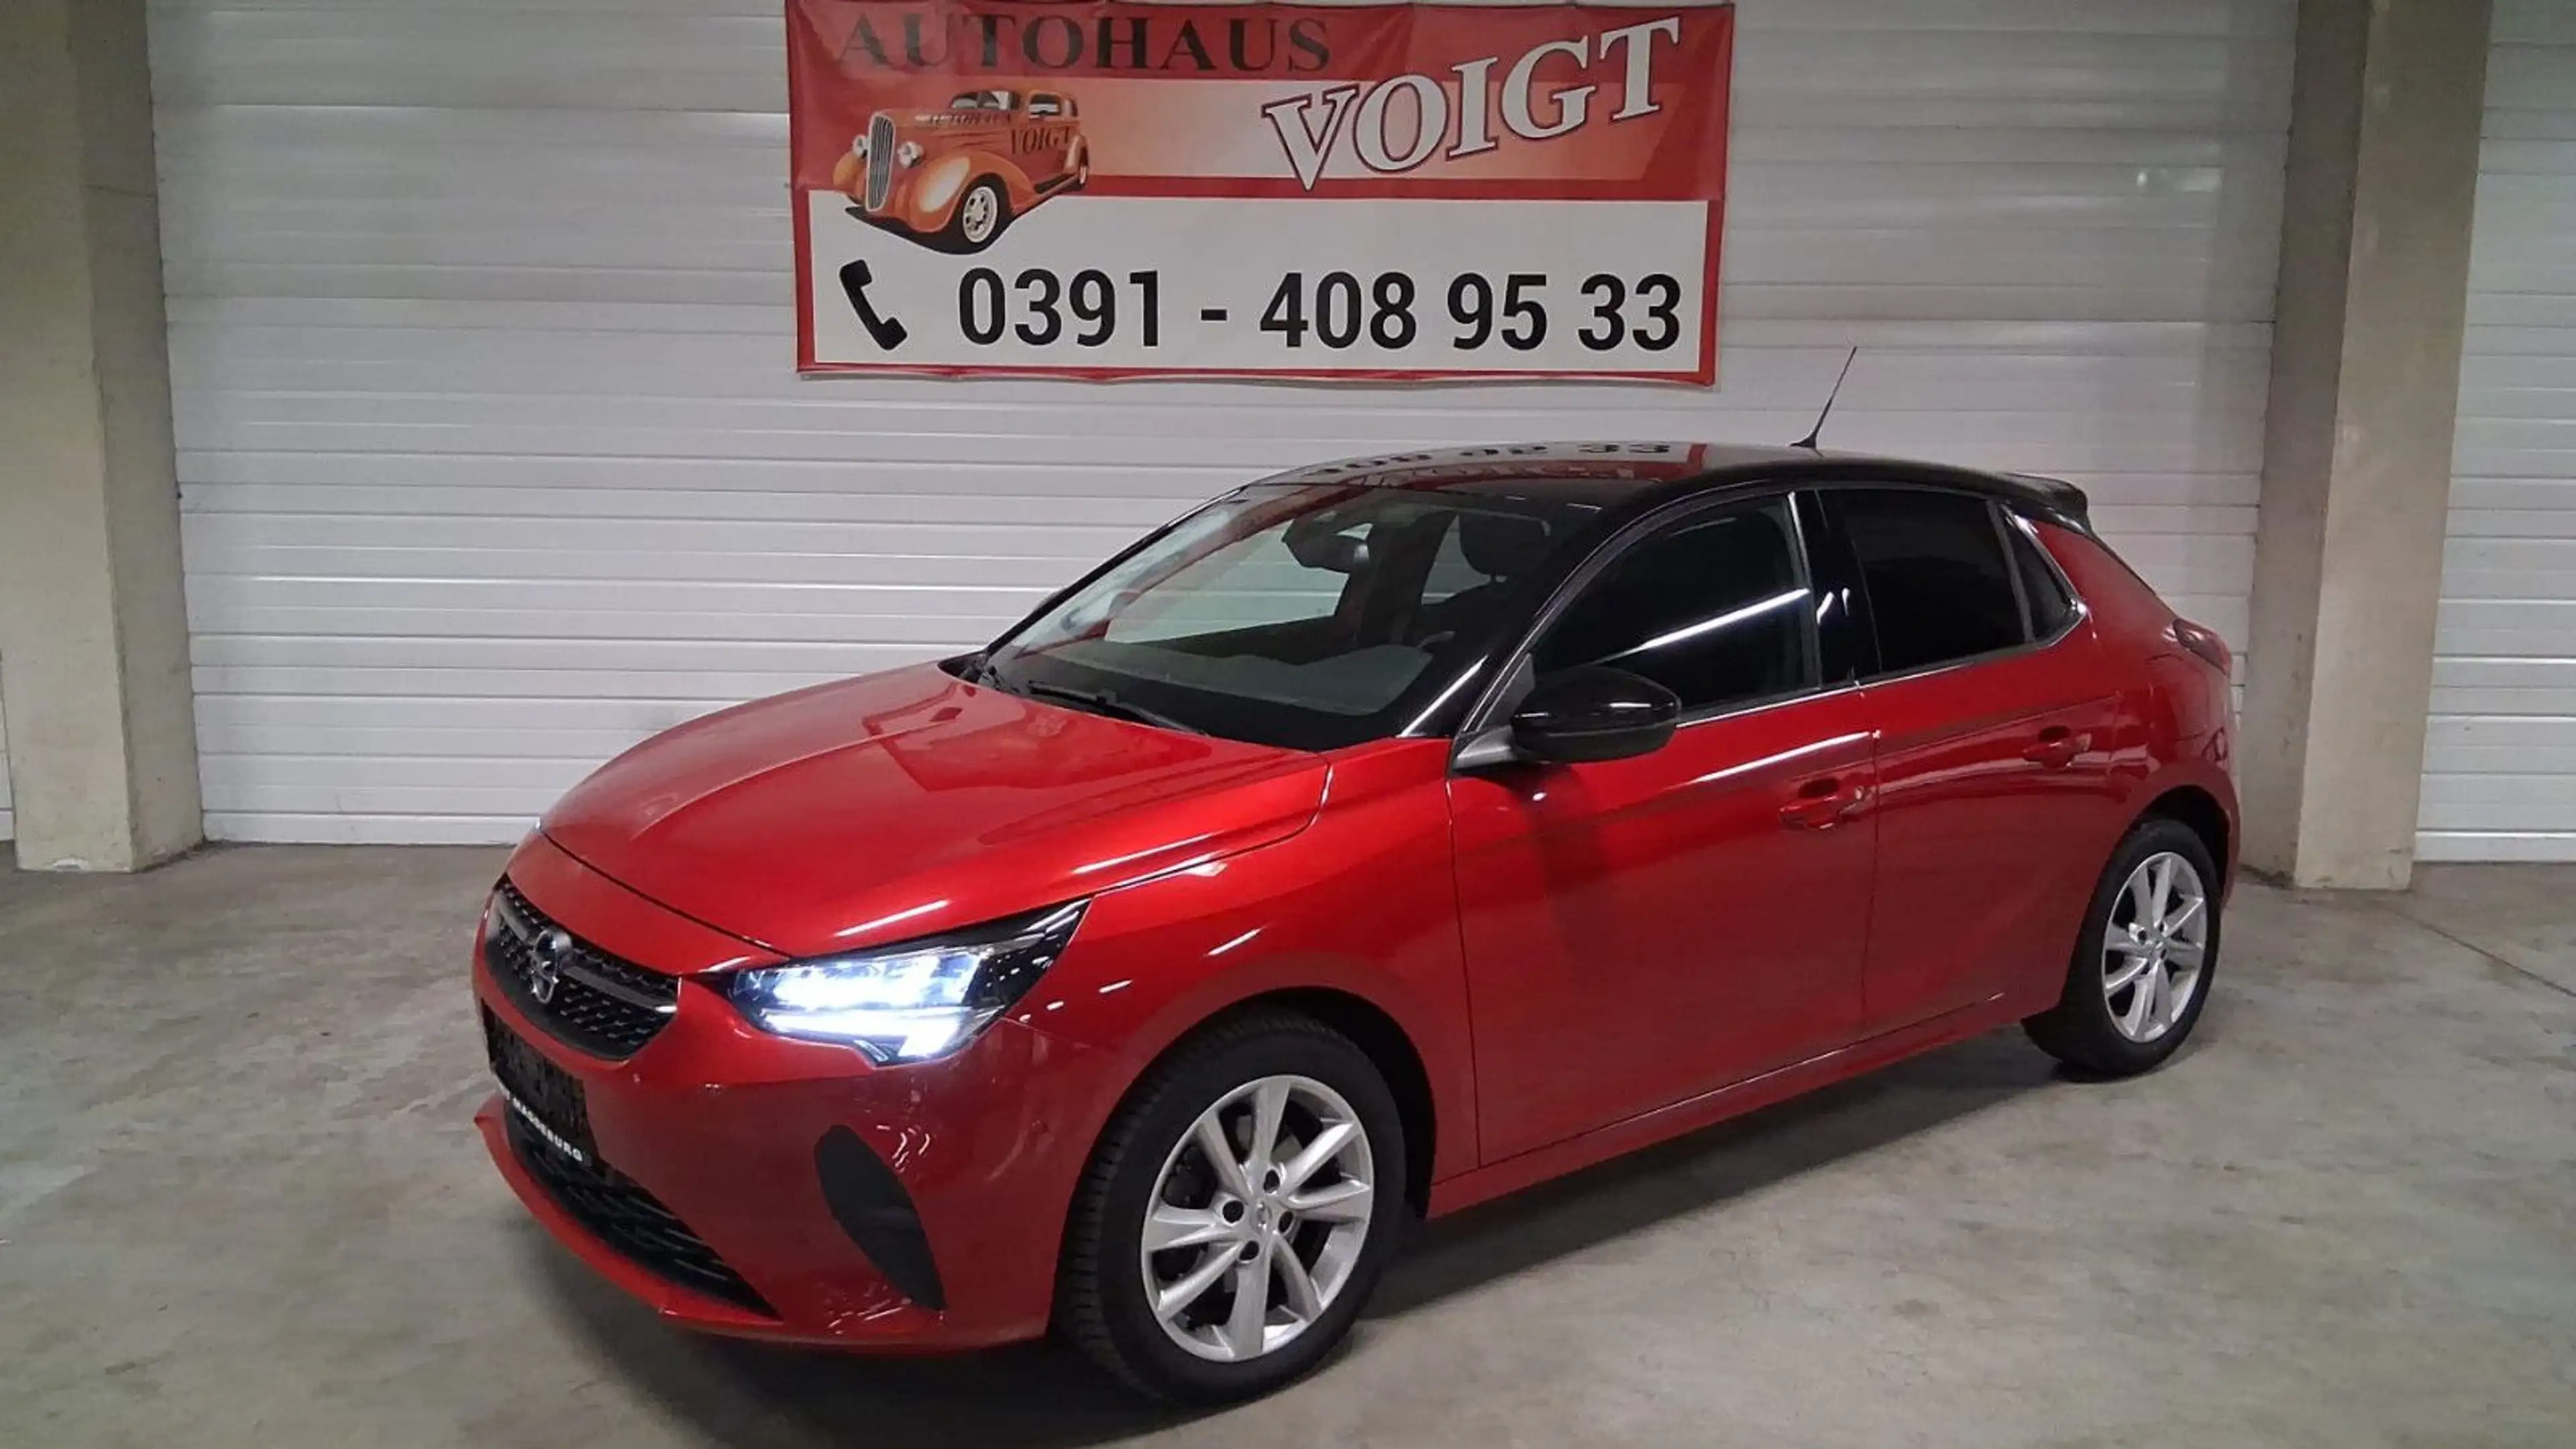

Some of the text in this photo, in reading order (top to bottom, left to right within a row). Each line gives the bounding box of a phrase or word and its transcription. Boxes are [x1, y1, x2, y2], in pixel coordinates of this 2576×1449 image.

[840, 12, 1330, 72] AUTOHAUS
[1261, 16, 1679, 191] VOIGT
[1011, 126, 1070, 156] VOIGT
[959, 267, 1680, 351] 0391 - 408 95 33
